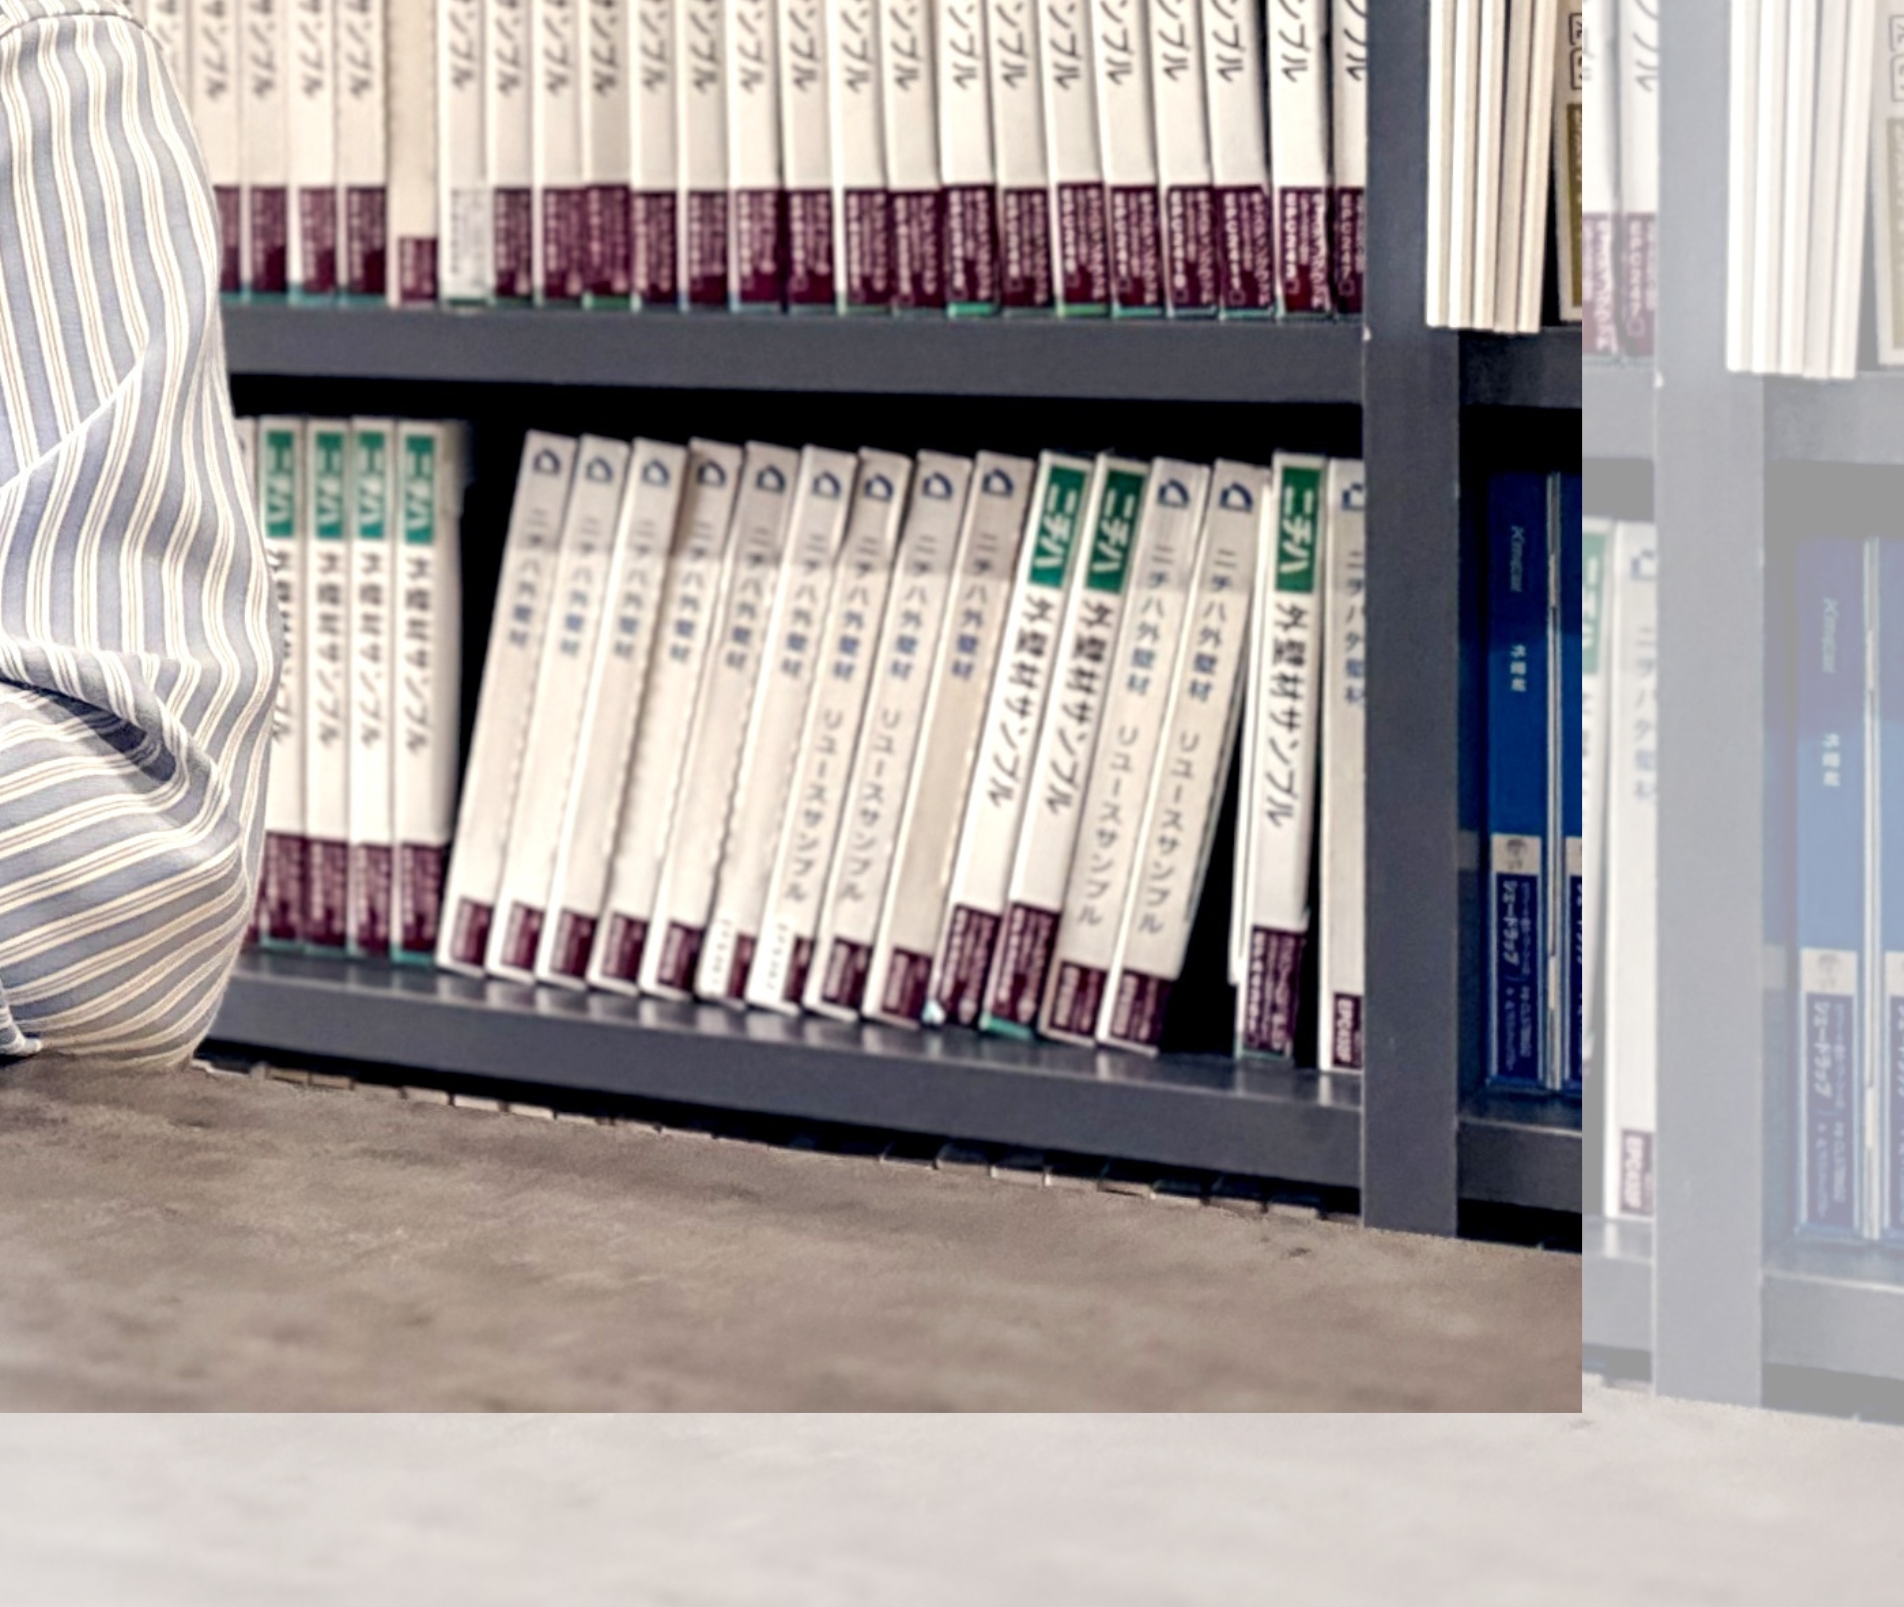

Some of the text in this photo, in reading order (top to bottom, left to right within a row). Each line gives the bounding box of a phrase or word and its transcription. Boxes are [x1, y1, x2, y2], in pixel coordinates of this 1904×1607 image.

[988, 485, 1077, 809] ニチハ 外壁材サンプル
[1045, 490, 1135, 816] ニチハ 外壁材サンプル
[1266, 486, 1315, 829] ニチハ 外壁材サンプル
